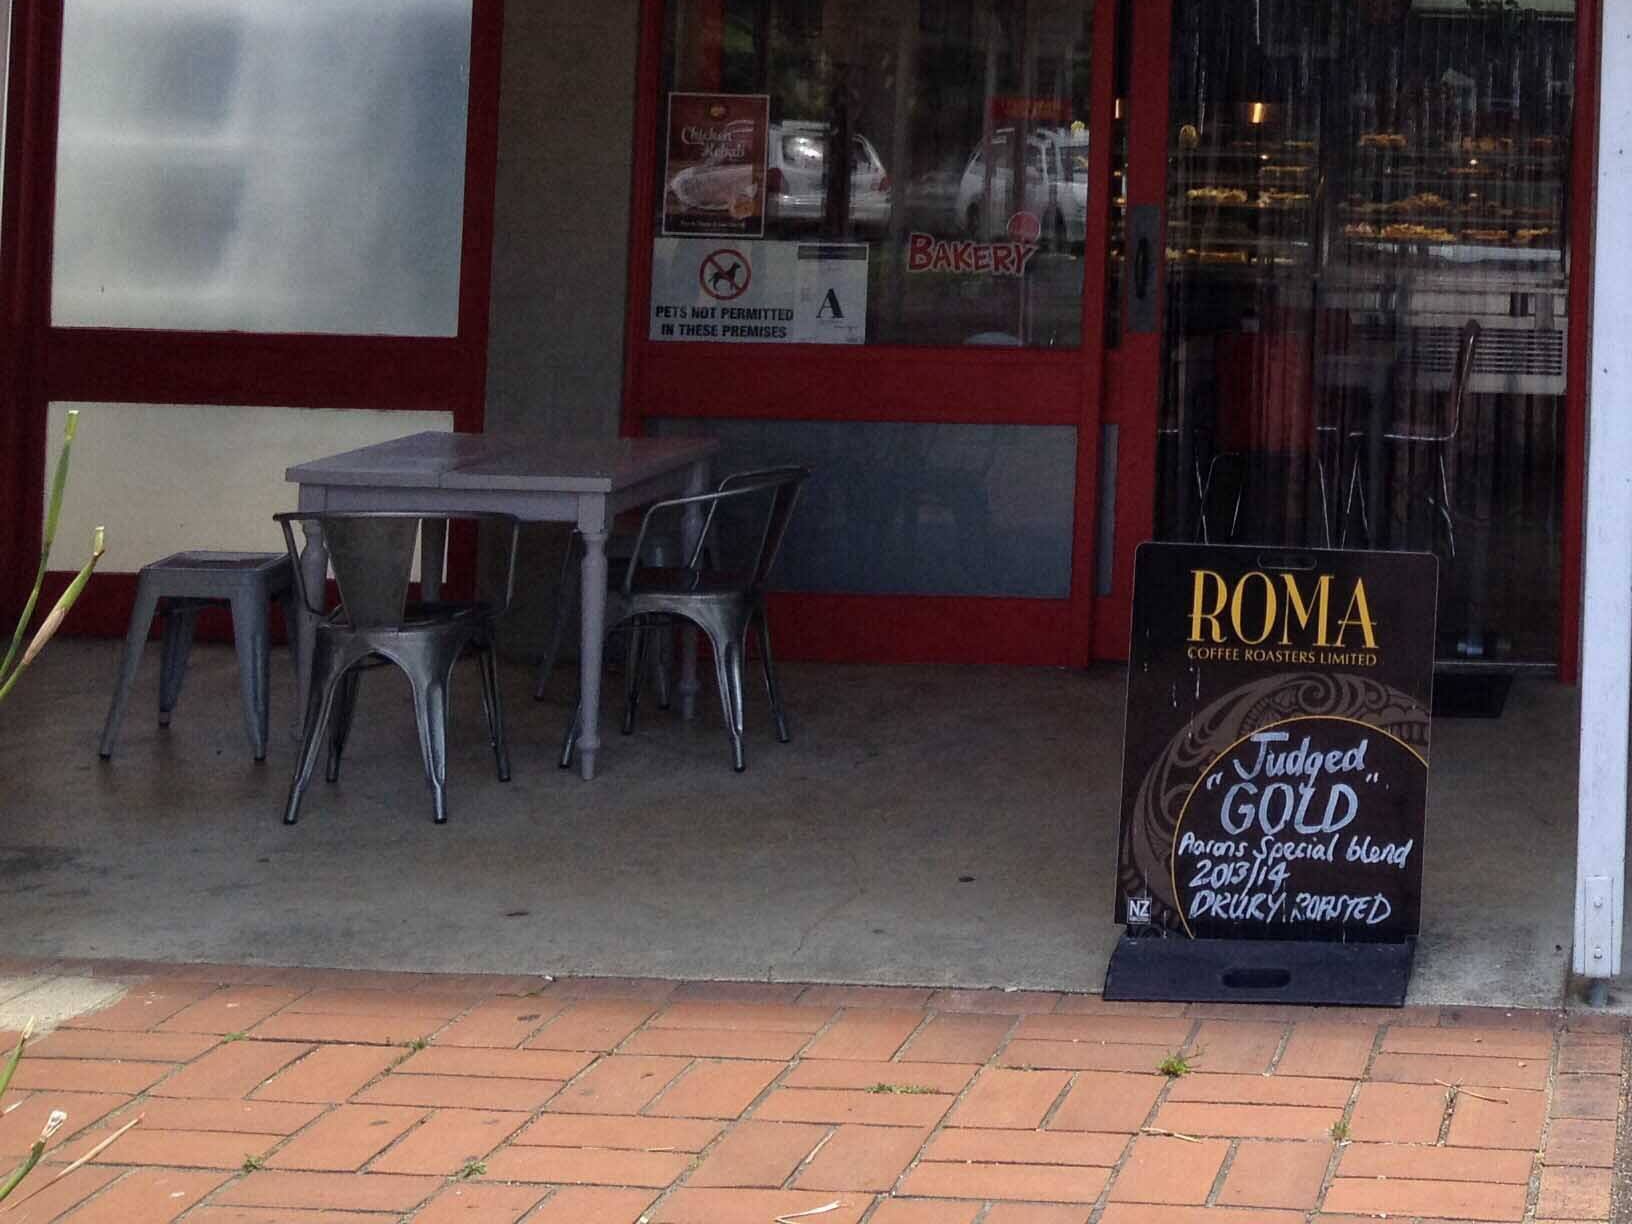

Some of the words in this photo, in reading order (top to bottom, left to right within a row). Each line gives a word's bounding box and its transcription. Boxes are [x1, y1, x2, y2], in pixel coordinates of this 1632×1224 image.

[907, 232, 1039, 276] BAKERY
[656, 306, 687, 319] PETS
[691, 307, 717, 320] NOT
[720, 307, 795, 322] PERMITTED
[816, 288, 844, 319] A
[661, 324, 674, 336] IN
[680, 324, 719, 337] THESE
[722, 325, 788, 338] PREMISES
[1187, 569, 1378, 648] ROMA
[1188, 646, 1240, 662] COFFEE
[1244, 648, 1315, 664] ROASTERS
[1320, 651, 1377, 666] LIMITED
[1233, 732, 1369, 789] Judged
[1253, 833, 1339, 866] Special
[1346, 835, 1413, 868] blend
[1129, 899, 1151, 917] NZ
[1188, 889, 1287, 923] DRURY
